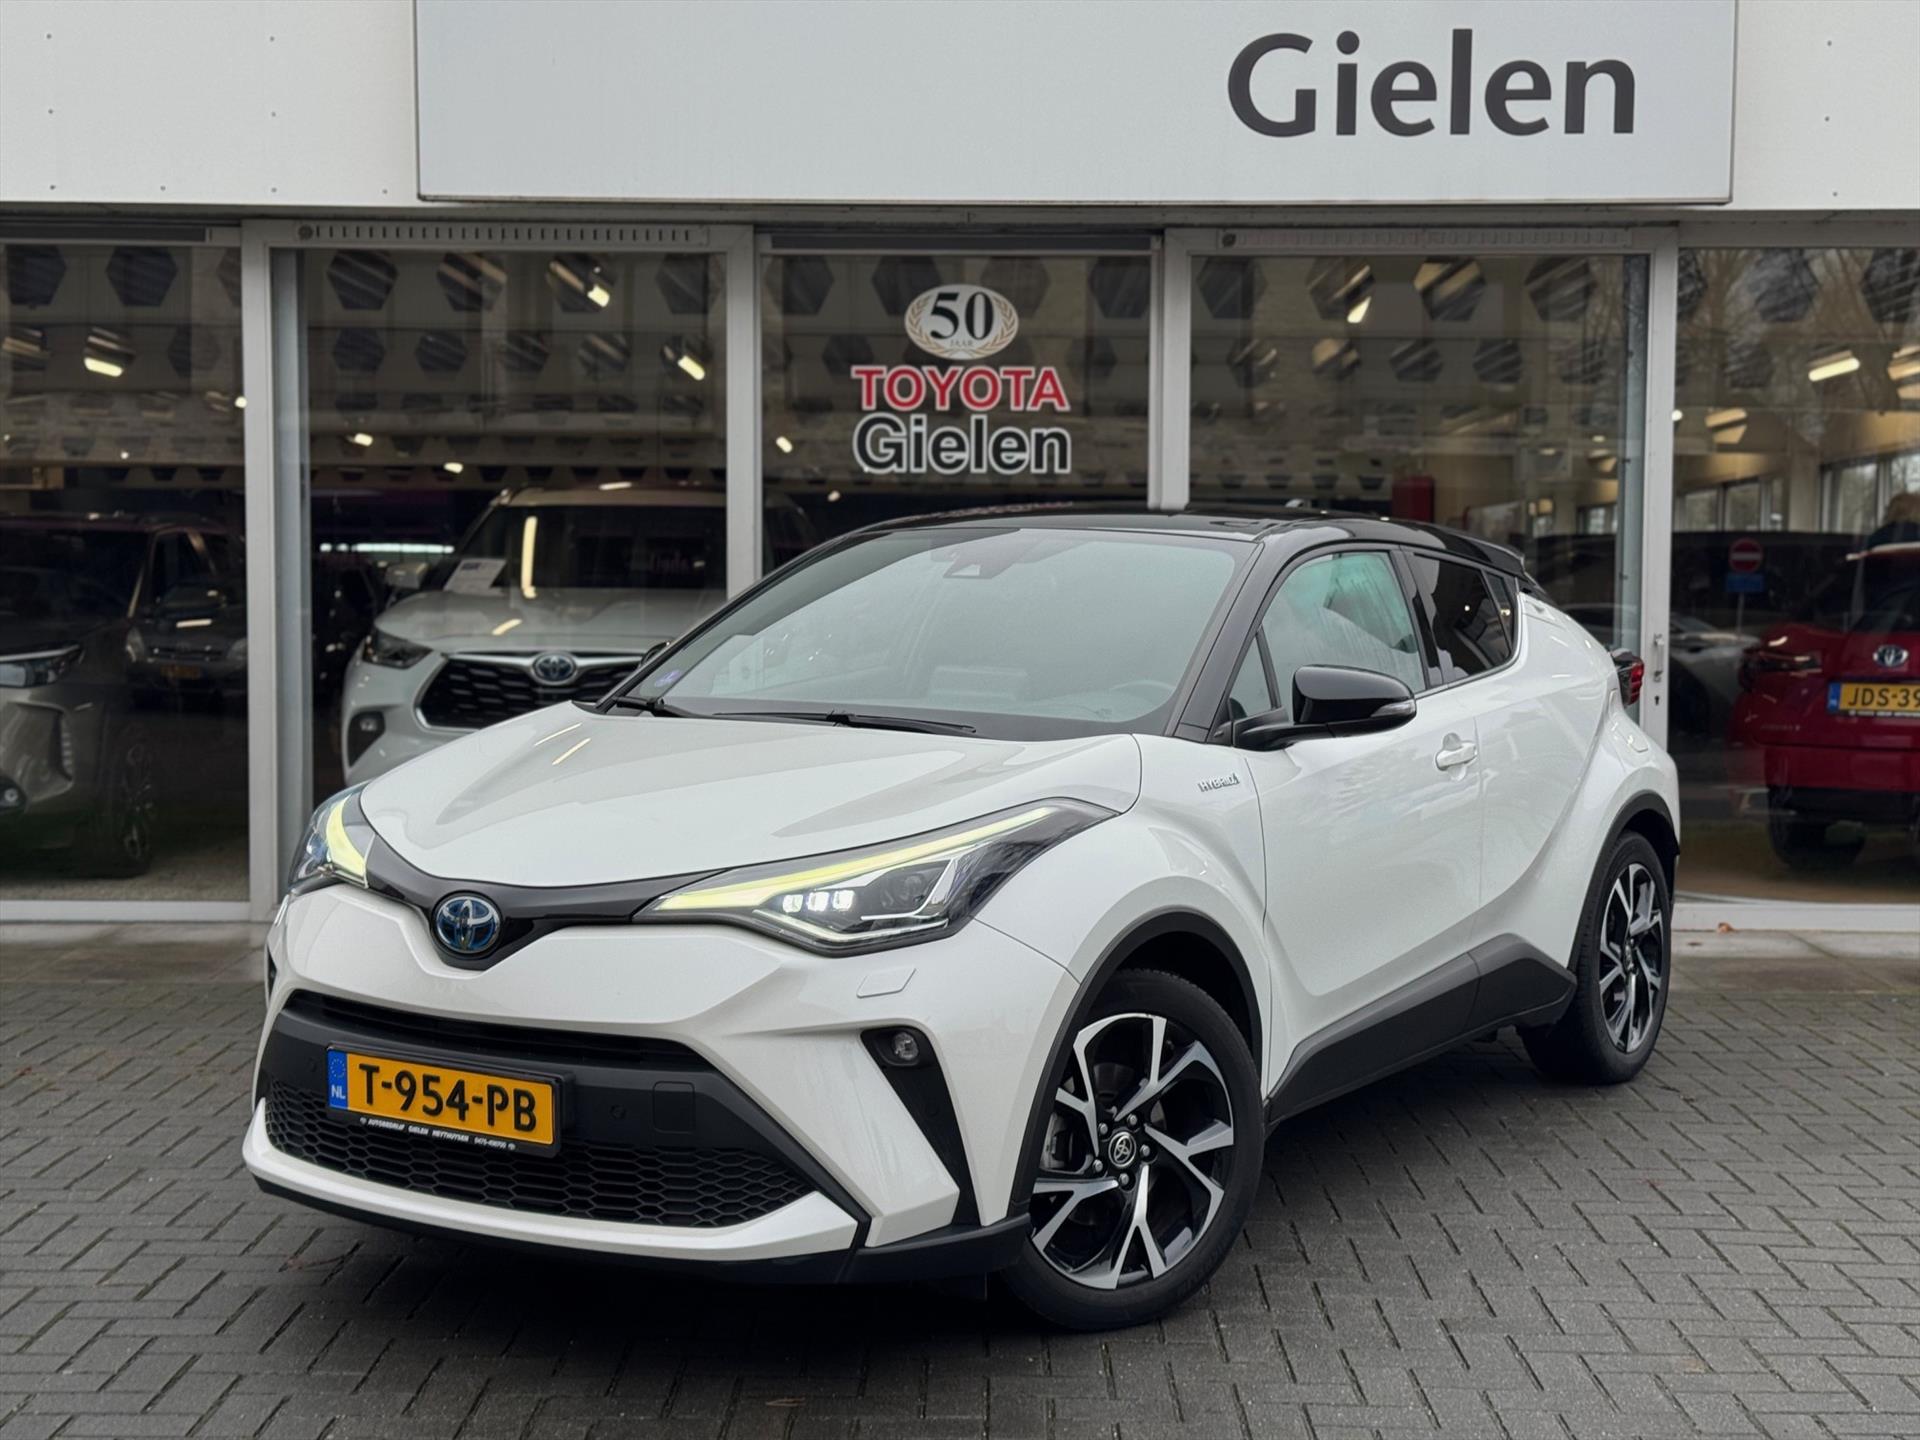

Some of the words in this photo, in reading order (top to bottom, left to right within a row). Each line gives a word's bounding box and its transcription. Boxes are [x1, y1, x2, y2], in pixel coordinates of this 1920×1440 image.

[1228, 28, 1636, 138] Gielen
[930, 291, 994, 340] 50
[950, 339, 974, 348] JAAR
[852, 366, 1070, 411] TOYOTA
[854, 412, 1071, 474] Gielen
[331, 1084, 346, 1100] NL
[358, 1063, 537, 1132] T-954-PB
[408, 1124, 429, 1135] GIELEN
